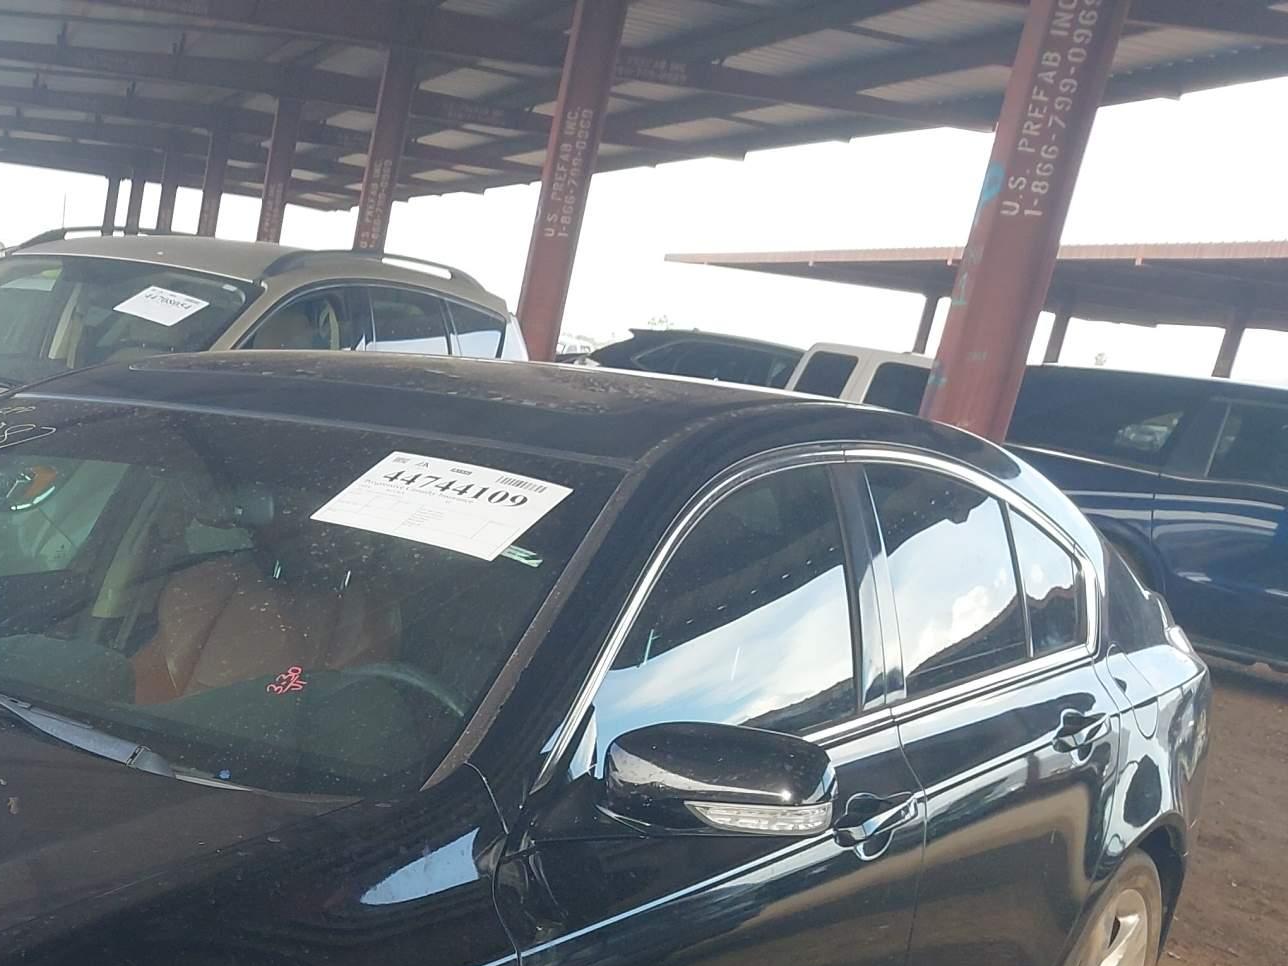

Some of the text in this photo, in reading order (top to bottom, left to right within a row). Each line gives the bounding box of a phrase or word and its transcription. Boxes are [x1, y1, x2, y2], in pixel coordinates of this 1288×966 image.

[1000, 169, 1032, 216] U.S.
[1017, 51, 1062, 153] PREFAB
[382, 469, 529, 508] 44744109
